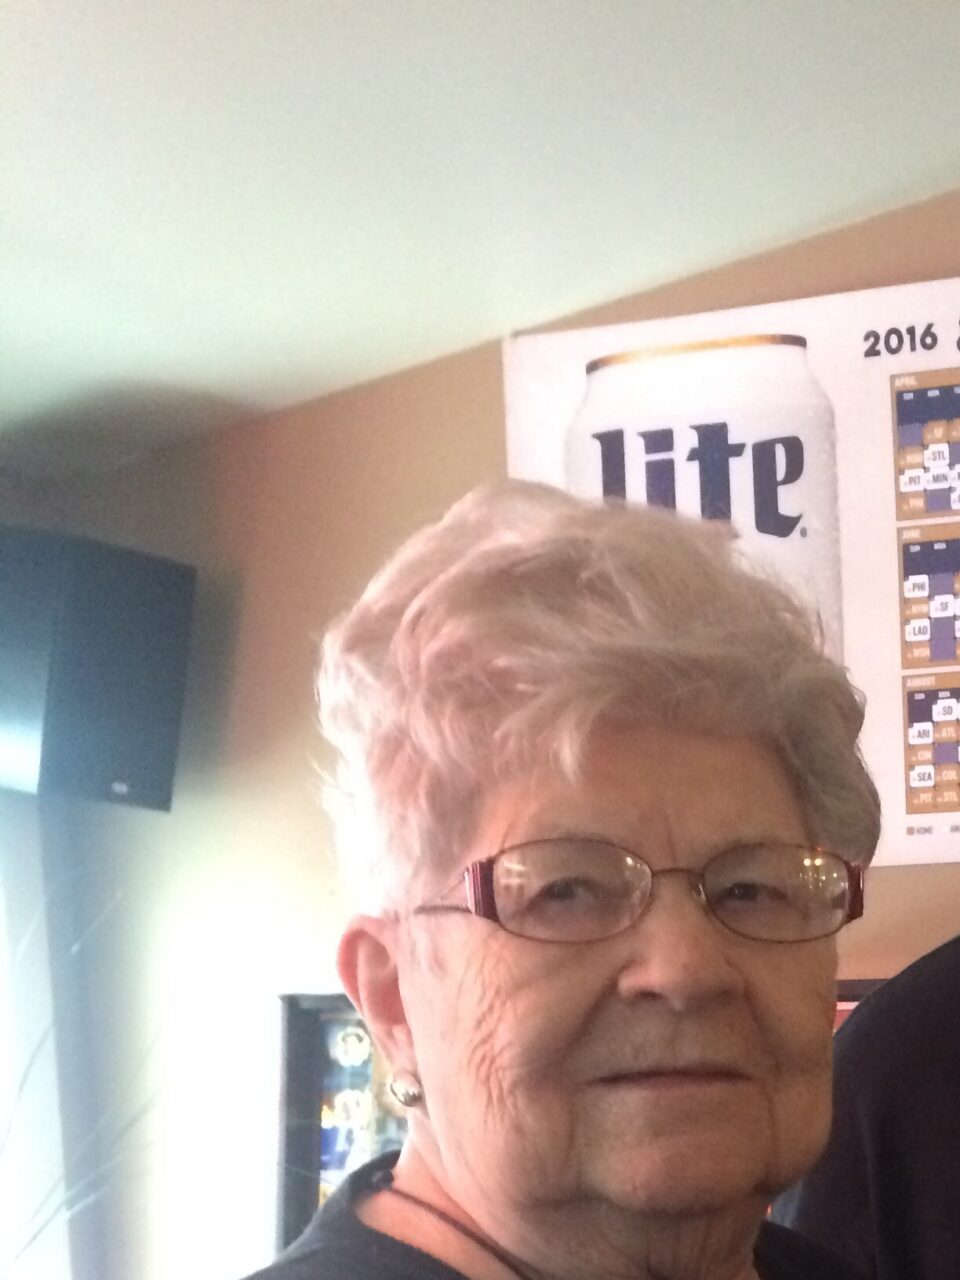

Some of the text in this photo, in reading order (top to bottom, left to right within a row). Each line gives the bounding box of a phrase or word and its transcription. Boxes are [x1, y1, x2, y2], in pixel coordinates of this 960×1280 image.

[863, 322, 939, 358] 2016
[932, 451, 946, 461] STL
[908, 475, 921, 485] PIT
[932, 472, 948, 483] MIN
[913, 581, 926, 592] PHI
[940, 601, 949, 611] SF
[913, 625, 928, 636] LAD
[942, 706, 953, 716] SD
[917, 729, 930, 739] ARI
[917, 772, 932, 782] SEA
